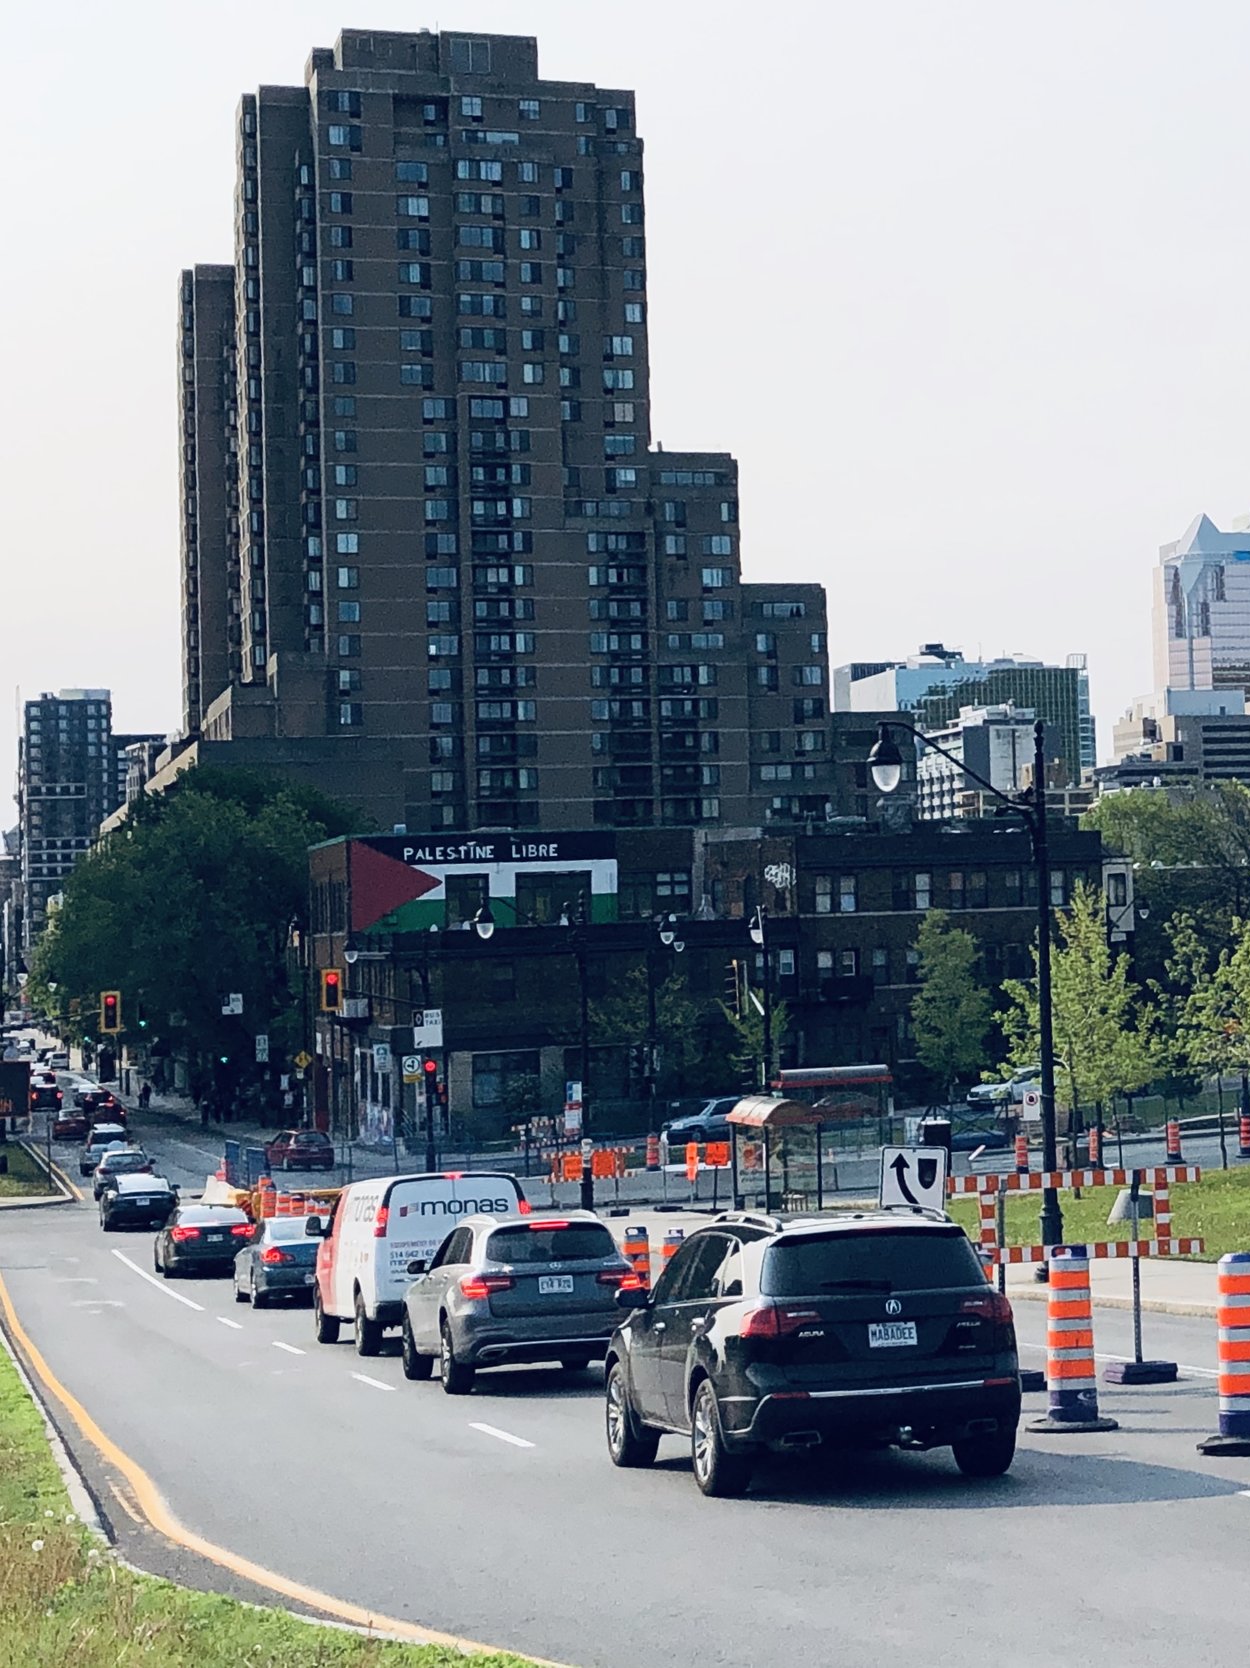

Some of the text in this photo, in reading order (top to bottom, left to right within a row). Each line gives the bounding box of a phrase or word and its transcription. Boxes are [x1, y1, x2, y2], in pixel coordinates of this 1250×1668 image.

[403, 841, 559, 861] PALESTINE LIBRE
[420, 1198, 509, 1216] monas
